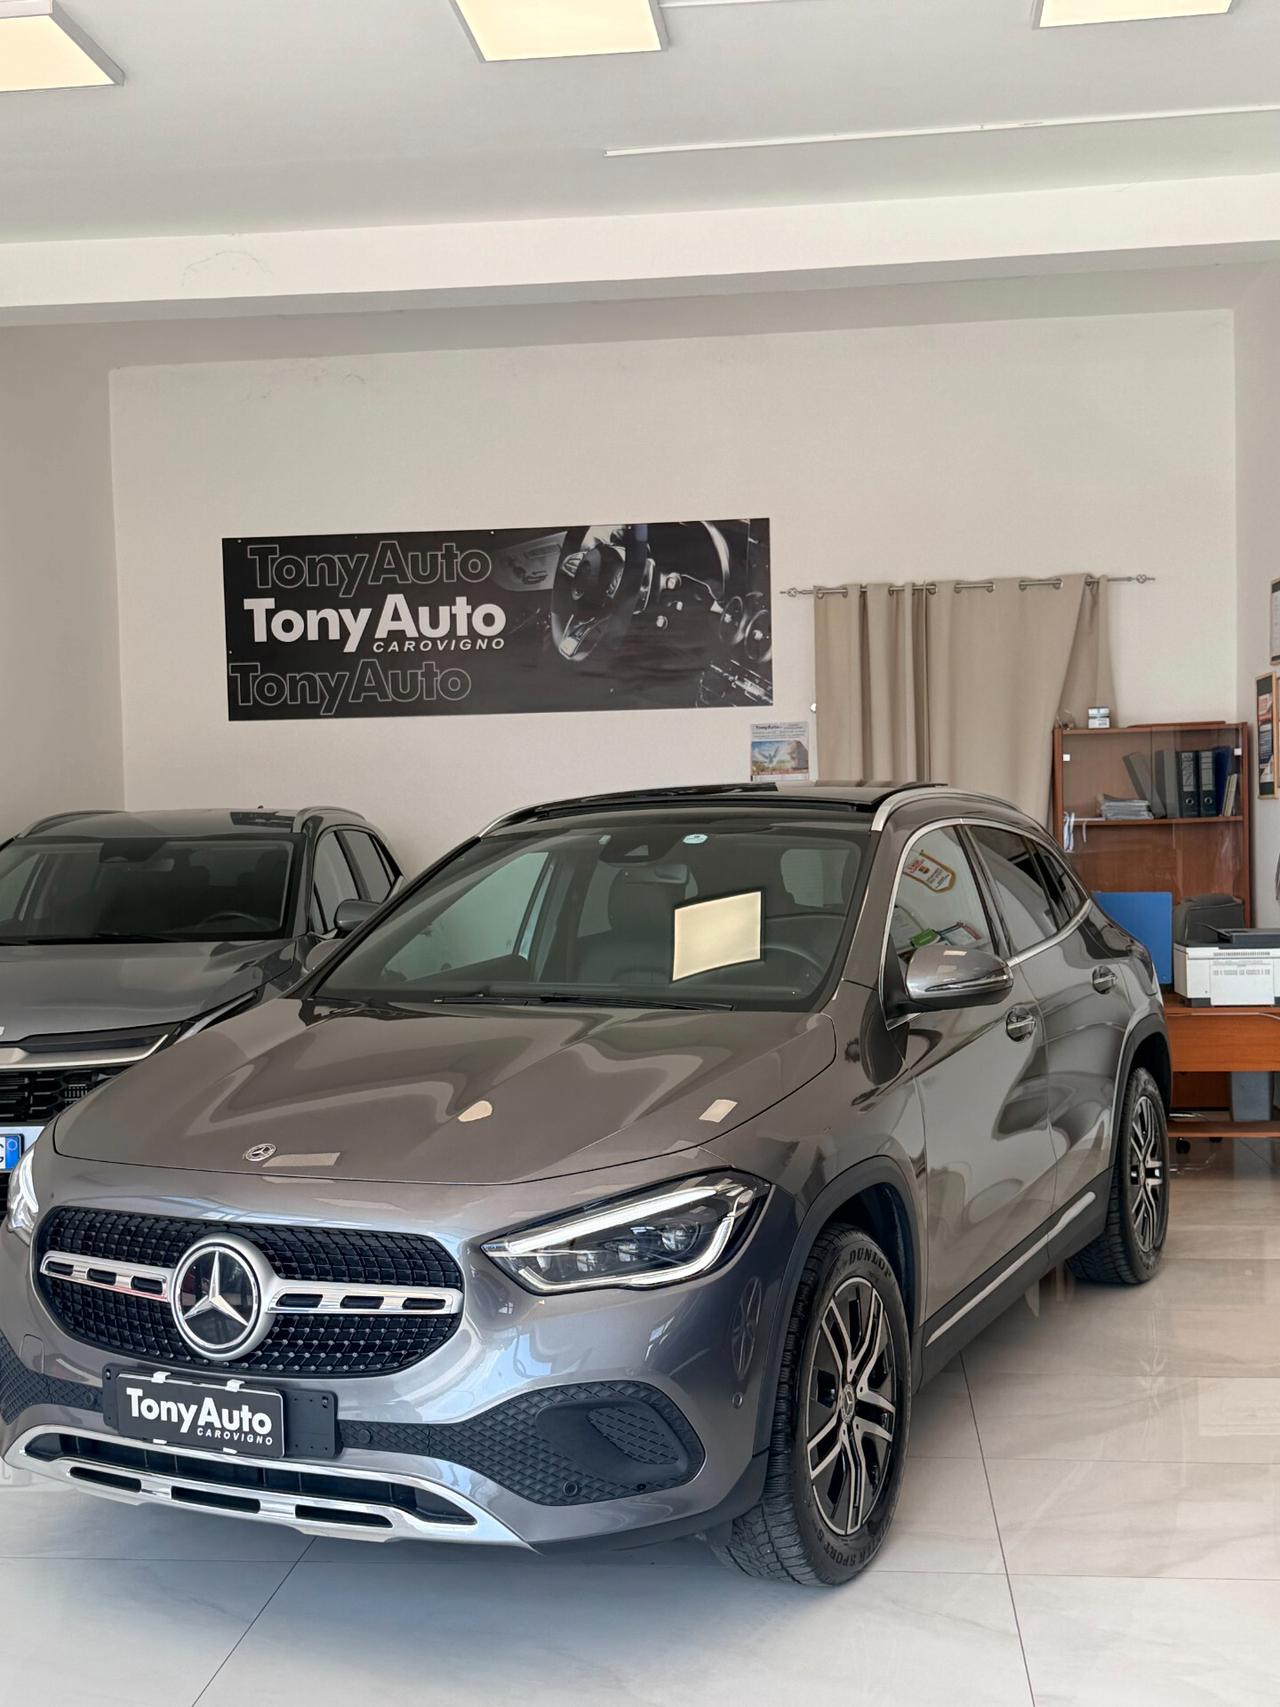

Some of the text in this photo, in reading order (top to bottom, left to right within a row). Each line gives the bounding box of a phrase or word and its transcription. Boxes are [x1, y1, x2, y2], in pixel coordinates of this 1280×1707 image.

[247, 540, 492, 597] TonyAuto
[243, 593, 507, 653] TonyAuto
[372, 636, 506, 654] CAROVIGNO
[229, 659, 472, 715] TonyAuto
[849, 1247, 892, 1278] DUNLOP
[126, 1387, 272, 1435] TonyAuto
[197, 1427, 273, 1446] CAROVIGNO
[824, 1541, 857, 1567] SPORT
